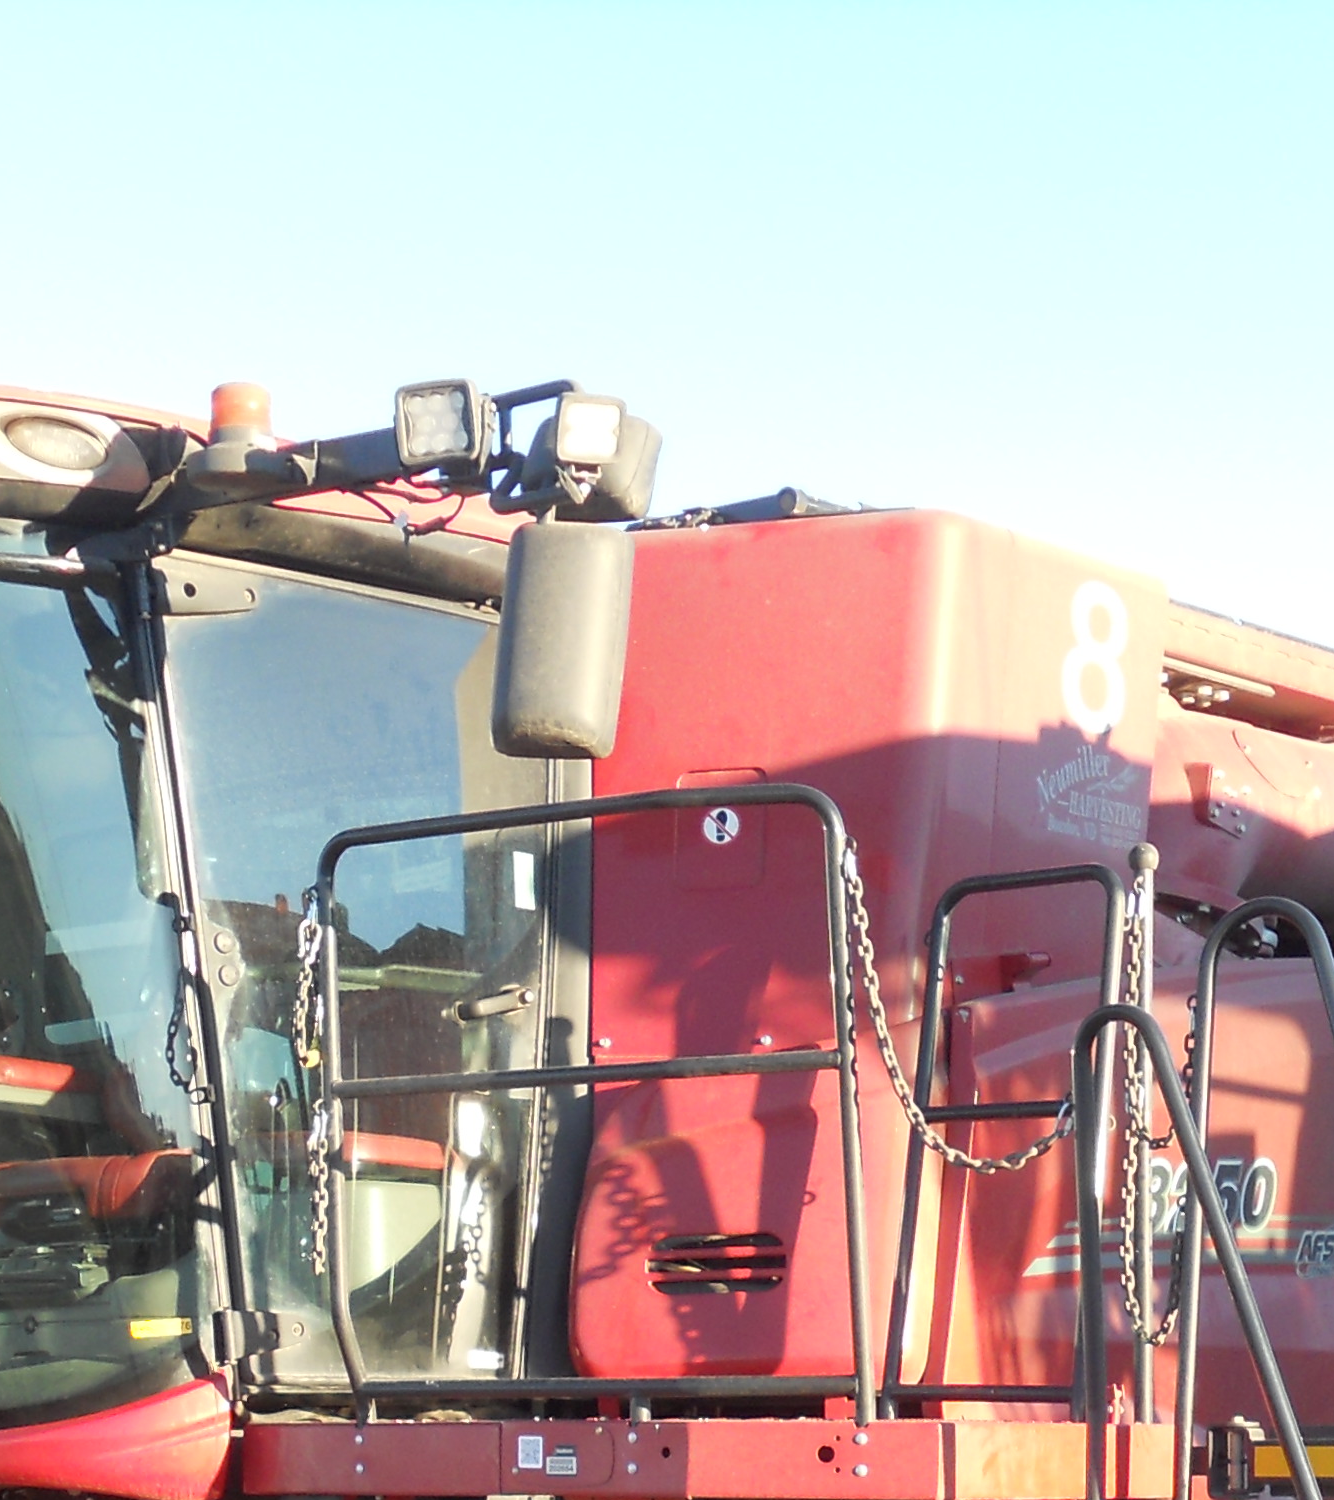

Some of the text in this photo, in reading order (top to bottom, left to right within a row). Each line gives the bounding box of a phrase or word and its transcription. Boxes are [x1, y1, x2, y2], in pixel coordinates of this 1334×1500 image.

[1061, 579, 1129, 735] 8
[1036, 744, 1109, 812] Neumiller
[1069, 790, 1142, 829] HARVESTING
